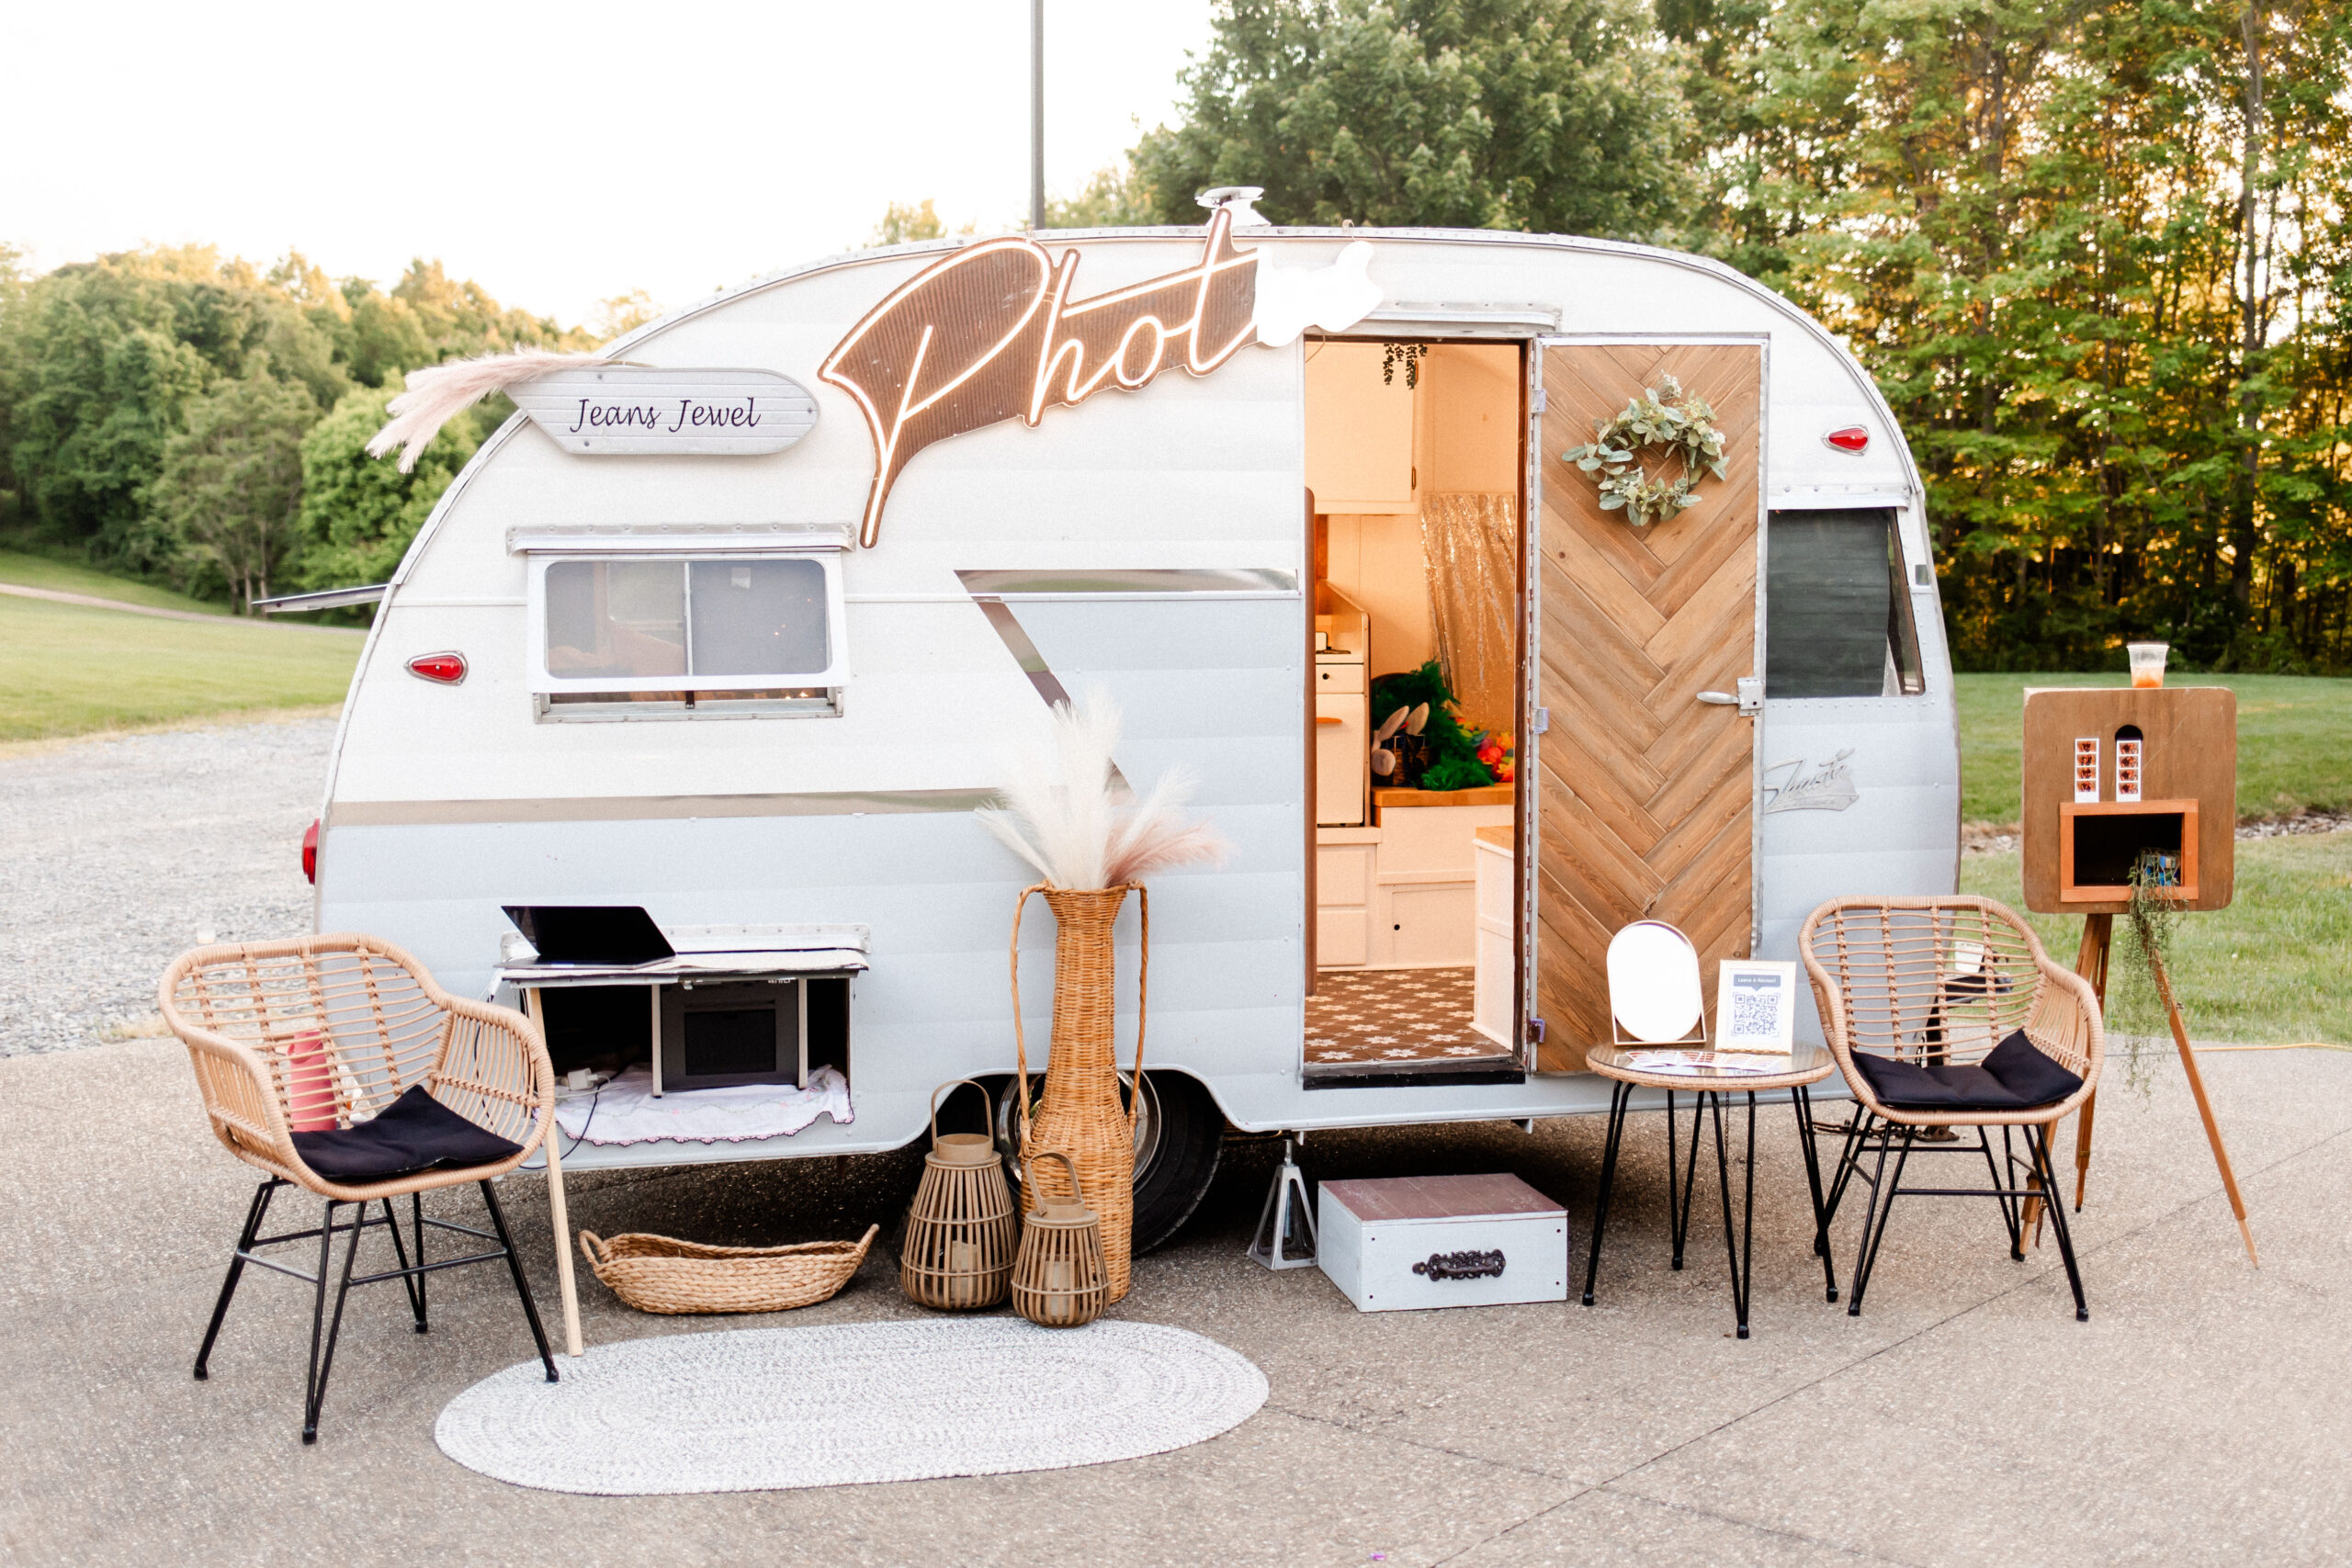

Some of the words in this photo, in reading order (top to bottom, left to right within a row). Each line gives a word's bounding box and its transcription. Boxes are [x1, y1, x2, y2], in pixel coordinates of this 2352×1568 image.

[570, 398, 662, 433] Jeans
[668, 396, 762, 433] Jewel
[820, 209, 1264, 547] Phot
